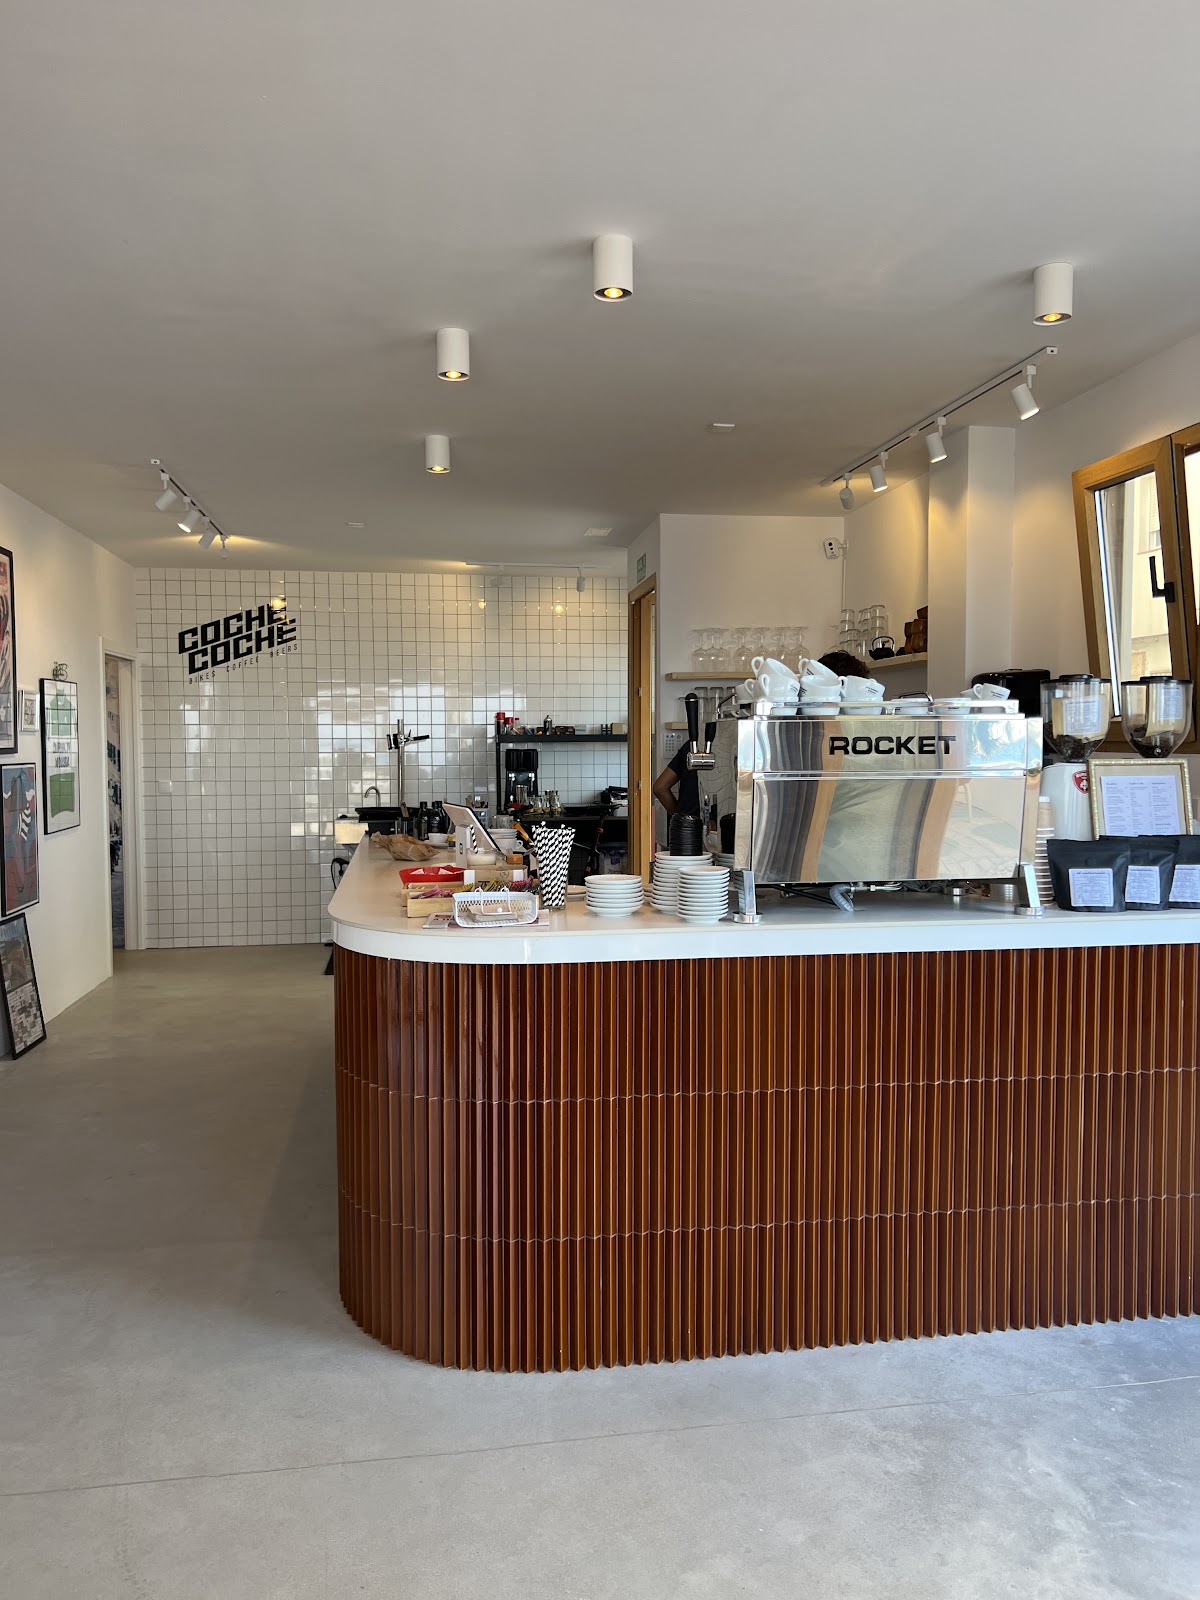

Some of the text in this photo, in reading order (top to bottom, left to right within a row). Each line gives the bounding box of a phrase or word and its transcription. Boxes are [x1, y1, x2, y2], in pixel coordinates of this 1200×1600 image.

[178, 598, 286, 655] COCHE
[189, 619, 297, 674] COCHE
[188, 643, 298, 685] BIKES COFFEE BEERS
[829, 735, 957, 756] ROCKET
